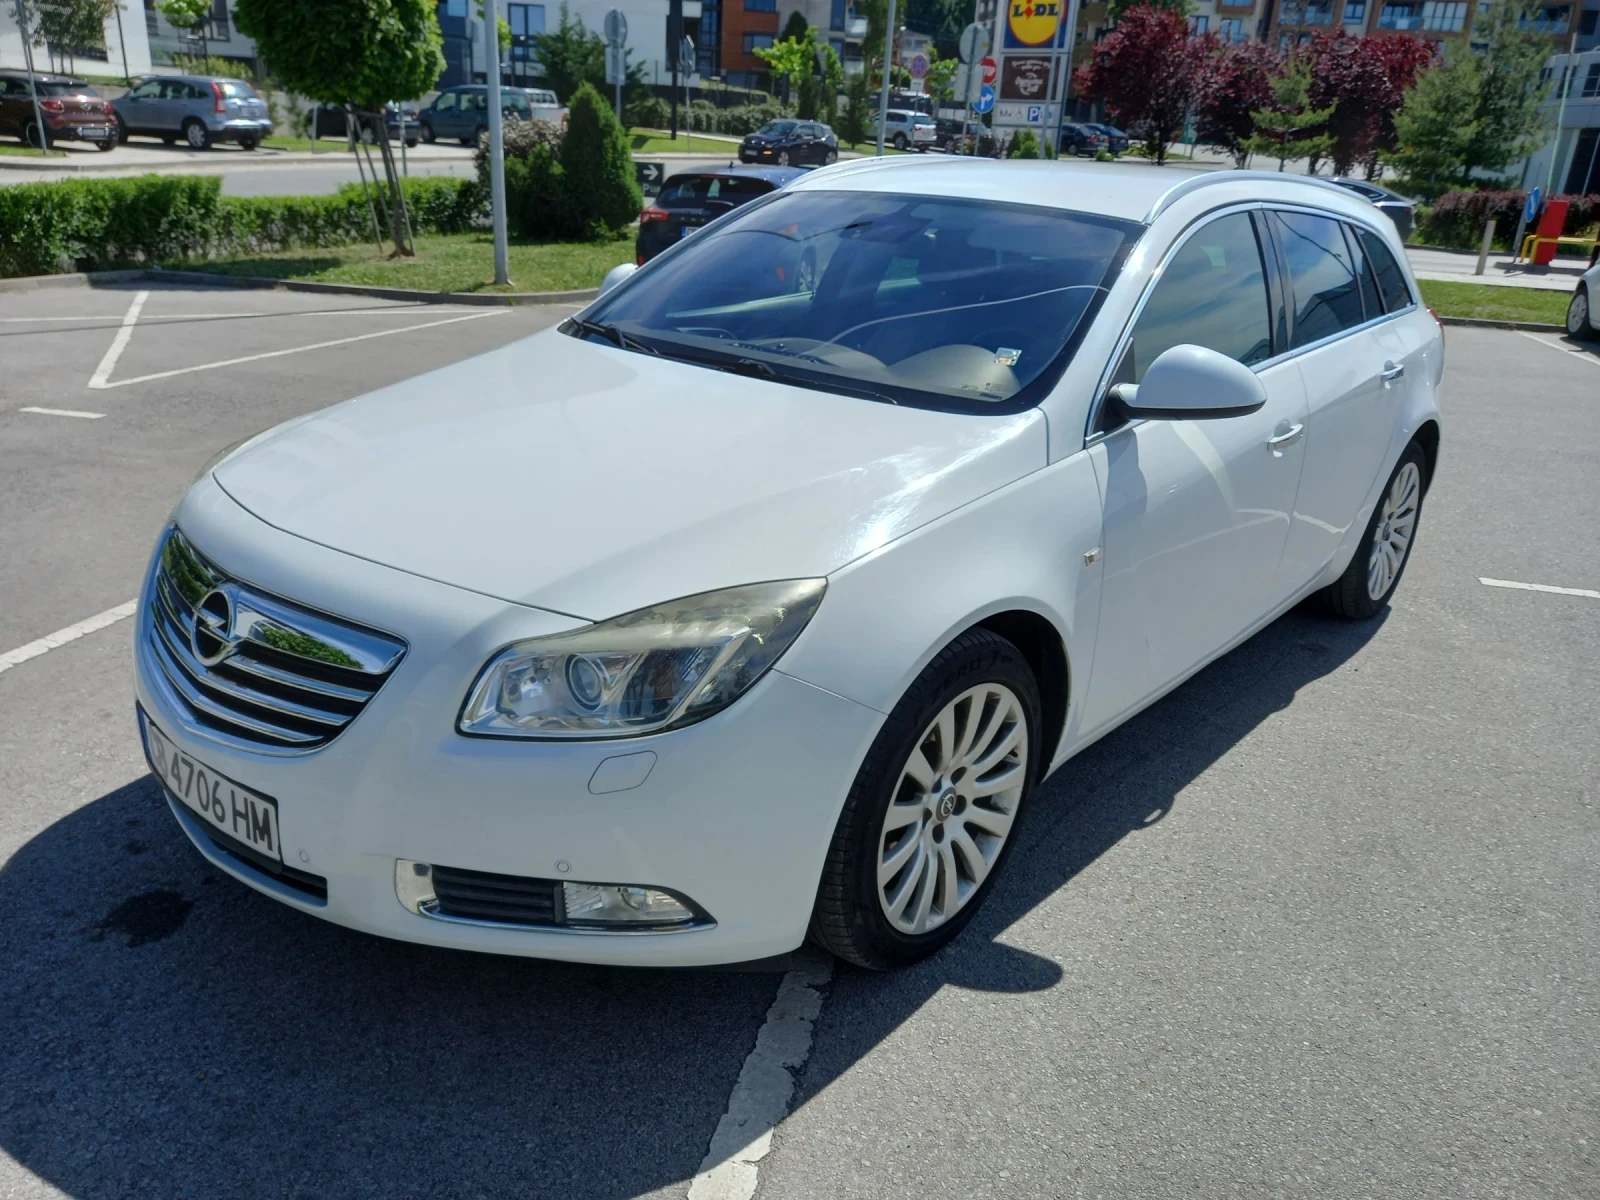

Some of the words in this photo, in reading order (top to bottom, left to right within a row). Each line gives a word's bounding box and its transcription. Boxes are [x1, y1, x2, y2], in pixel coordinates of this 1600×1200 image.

[1013, 3, 1058, 17] LIDL
[171, 752, 225, 823] 4706
[230, 790, 273, 851] HM
